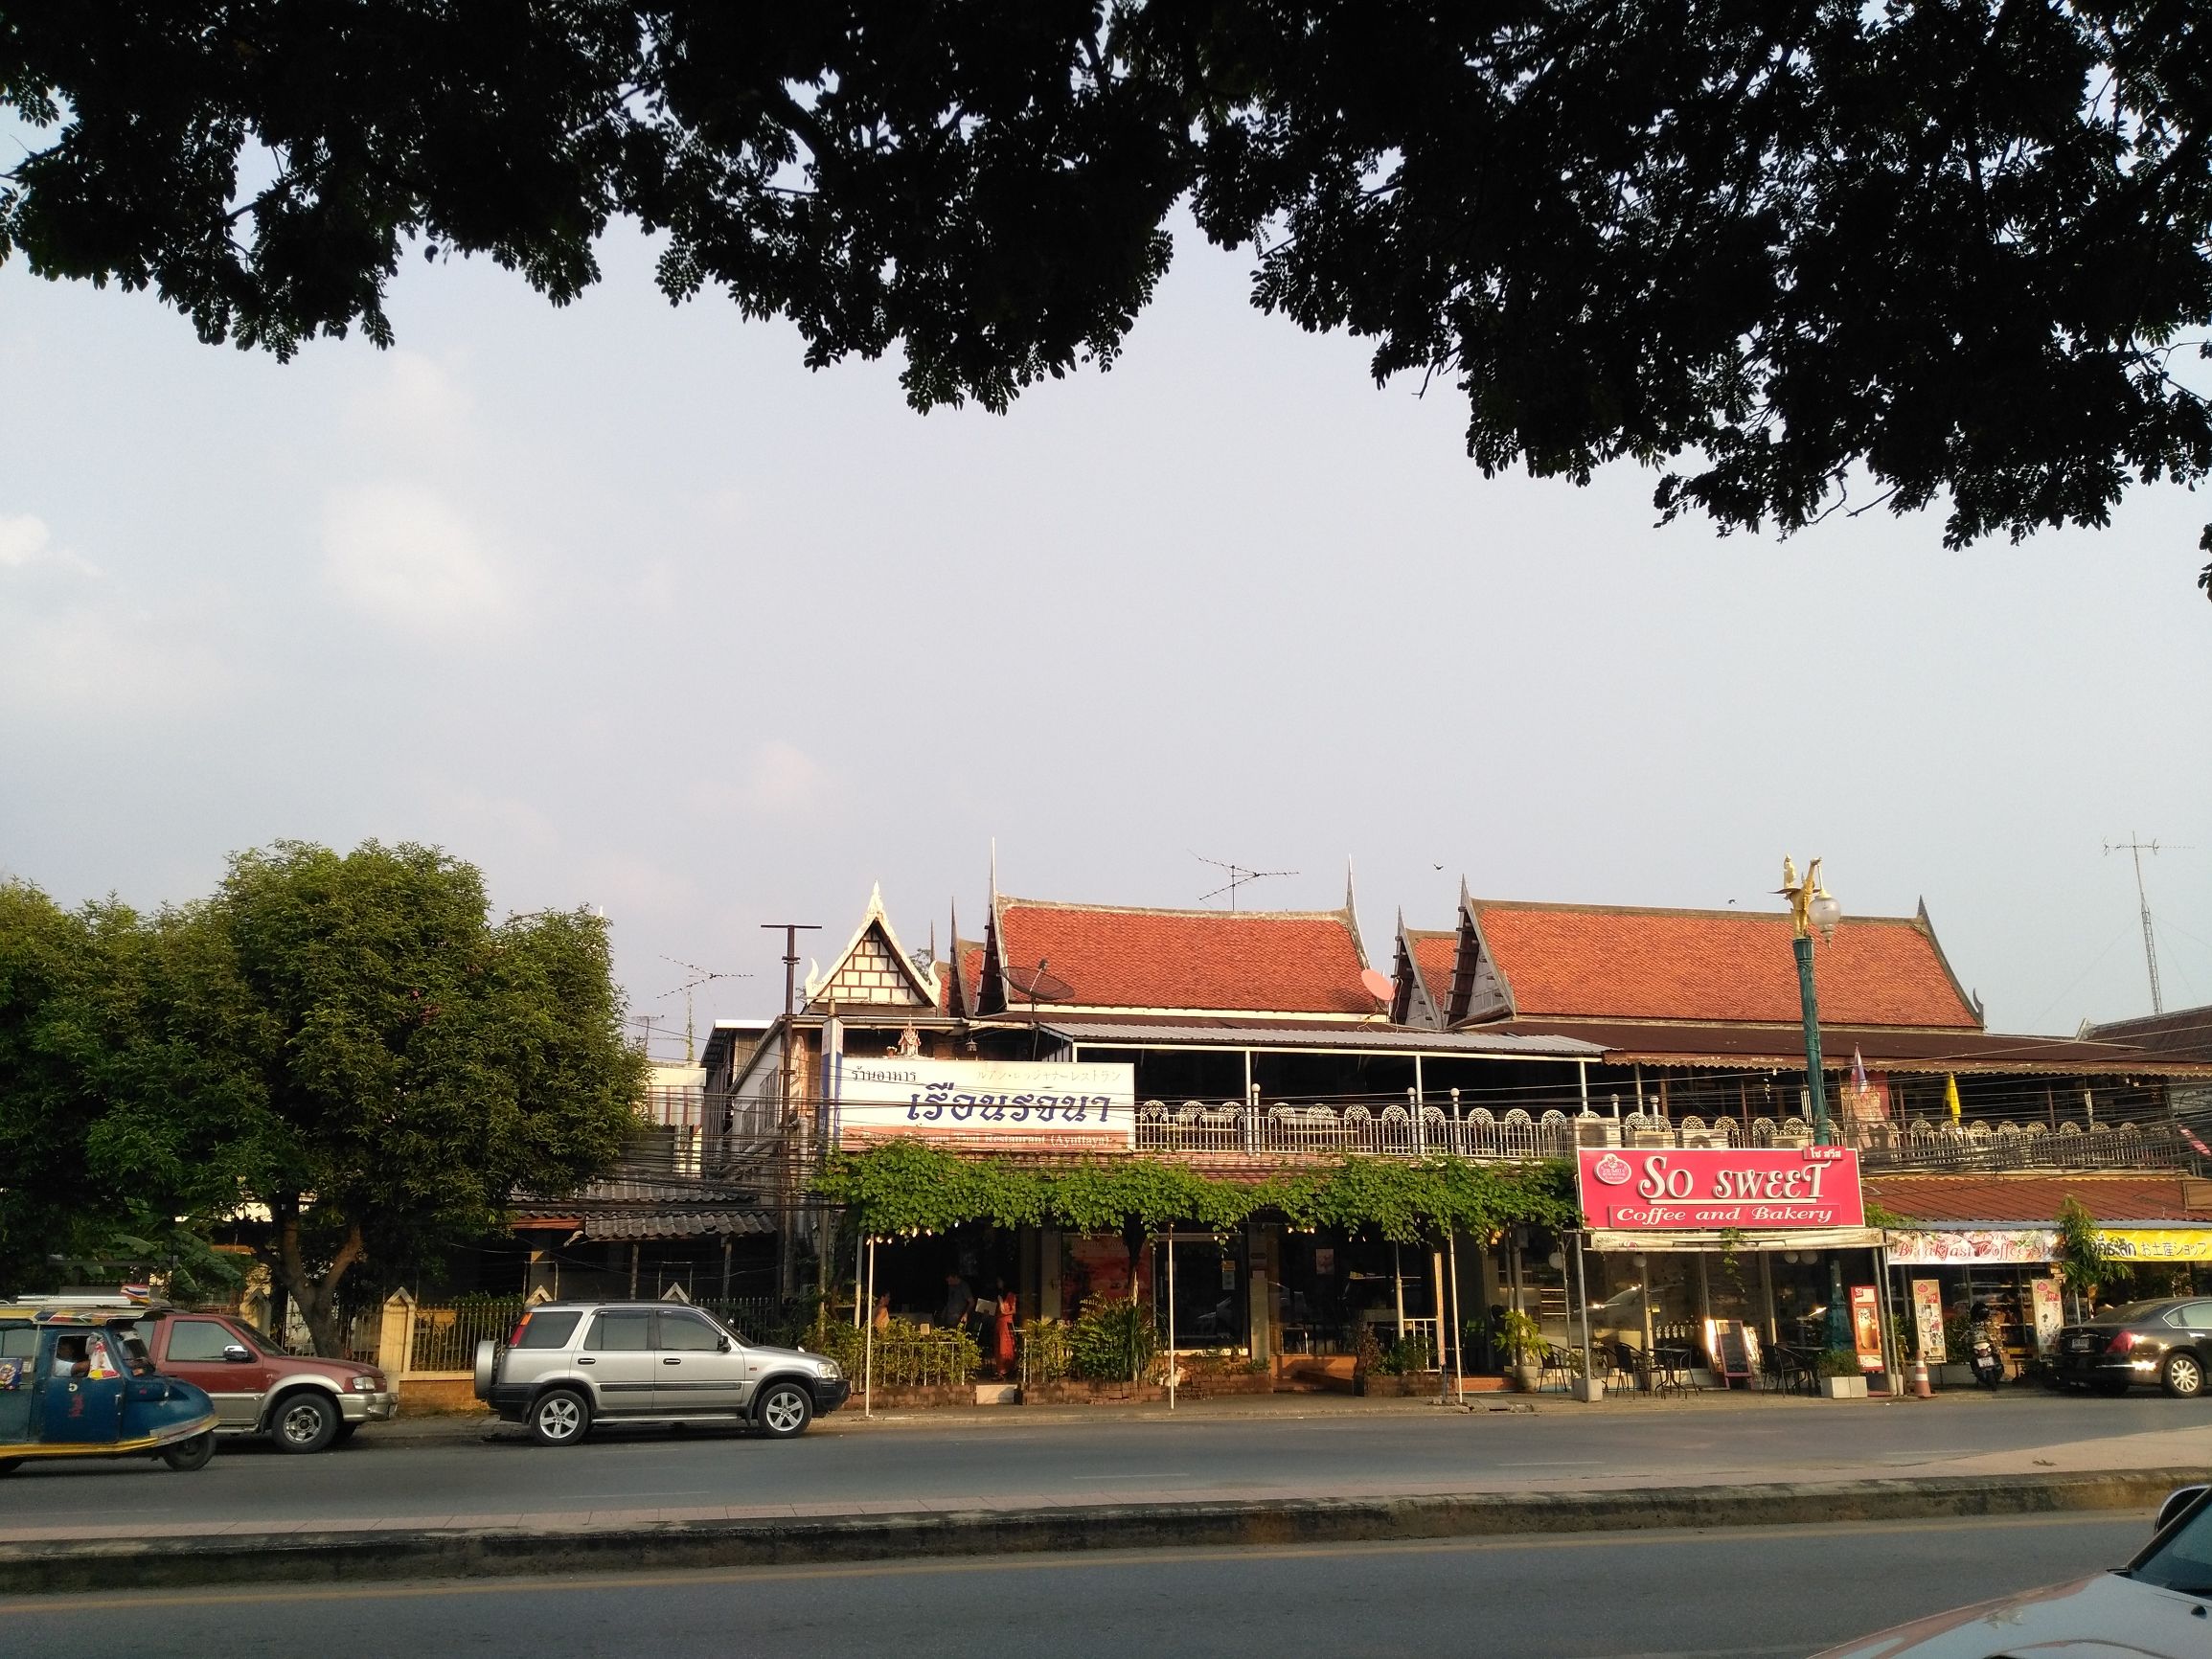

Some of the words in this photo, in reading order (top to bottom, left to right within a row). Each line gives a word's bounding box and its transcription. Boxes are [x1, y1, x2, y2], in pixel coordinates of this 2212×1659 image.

[851, 1065, 917, 1082] ร้านอาหาร
[1616, 1208, 1686, 1225] Coffee
[1695, 1208, 1741, 1221] and
[1751, 1206, 1833, 1223] Bakery
[1898, 1241, 1973, 1261] Breakfast
[1978, 1241, 2023, 1261] Coffee
